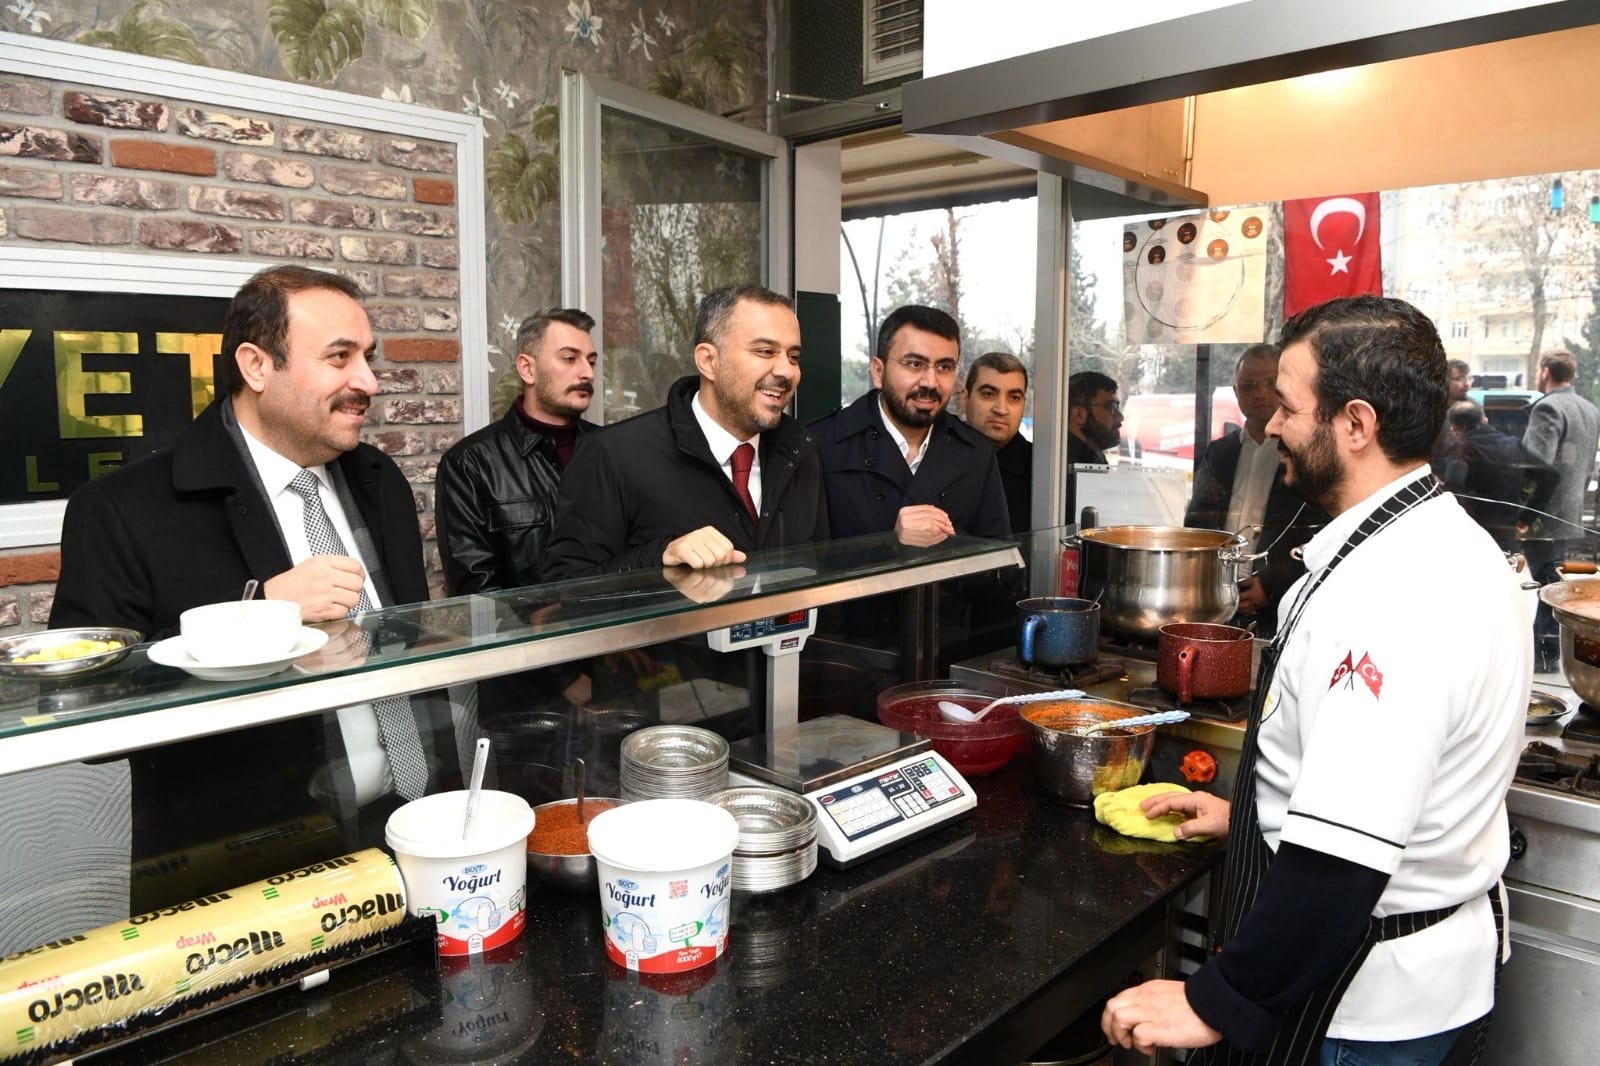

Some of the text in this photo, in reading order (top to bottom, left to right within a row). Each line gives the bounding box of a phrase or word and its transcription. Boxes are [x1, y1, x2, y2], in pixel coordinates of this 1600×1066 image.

[443, 868, 502, 894] Yoğurt
[606, 882, 656, 909] Yoğurt
[176, 931, 217, 949] Wrap
[186, 930, 286, 975] macro
[28, 973, 145, 1023] macro
